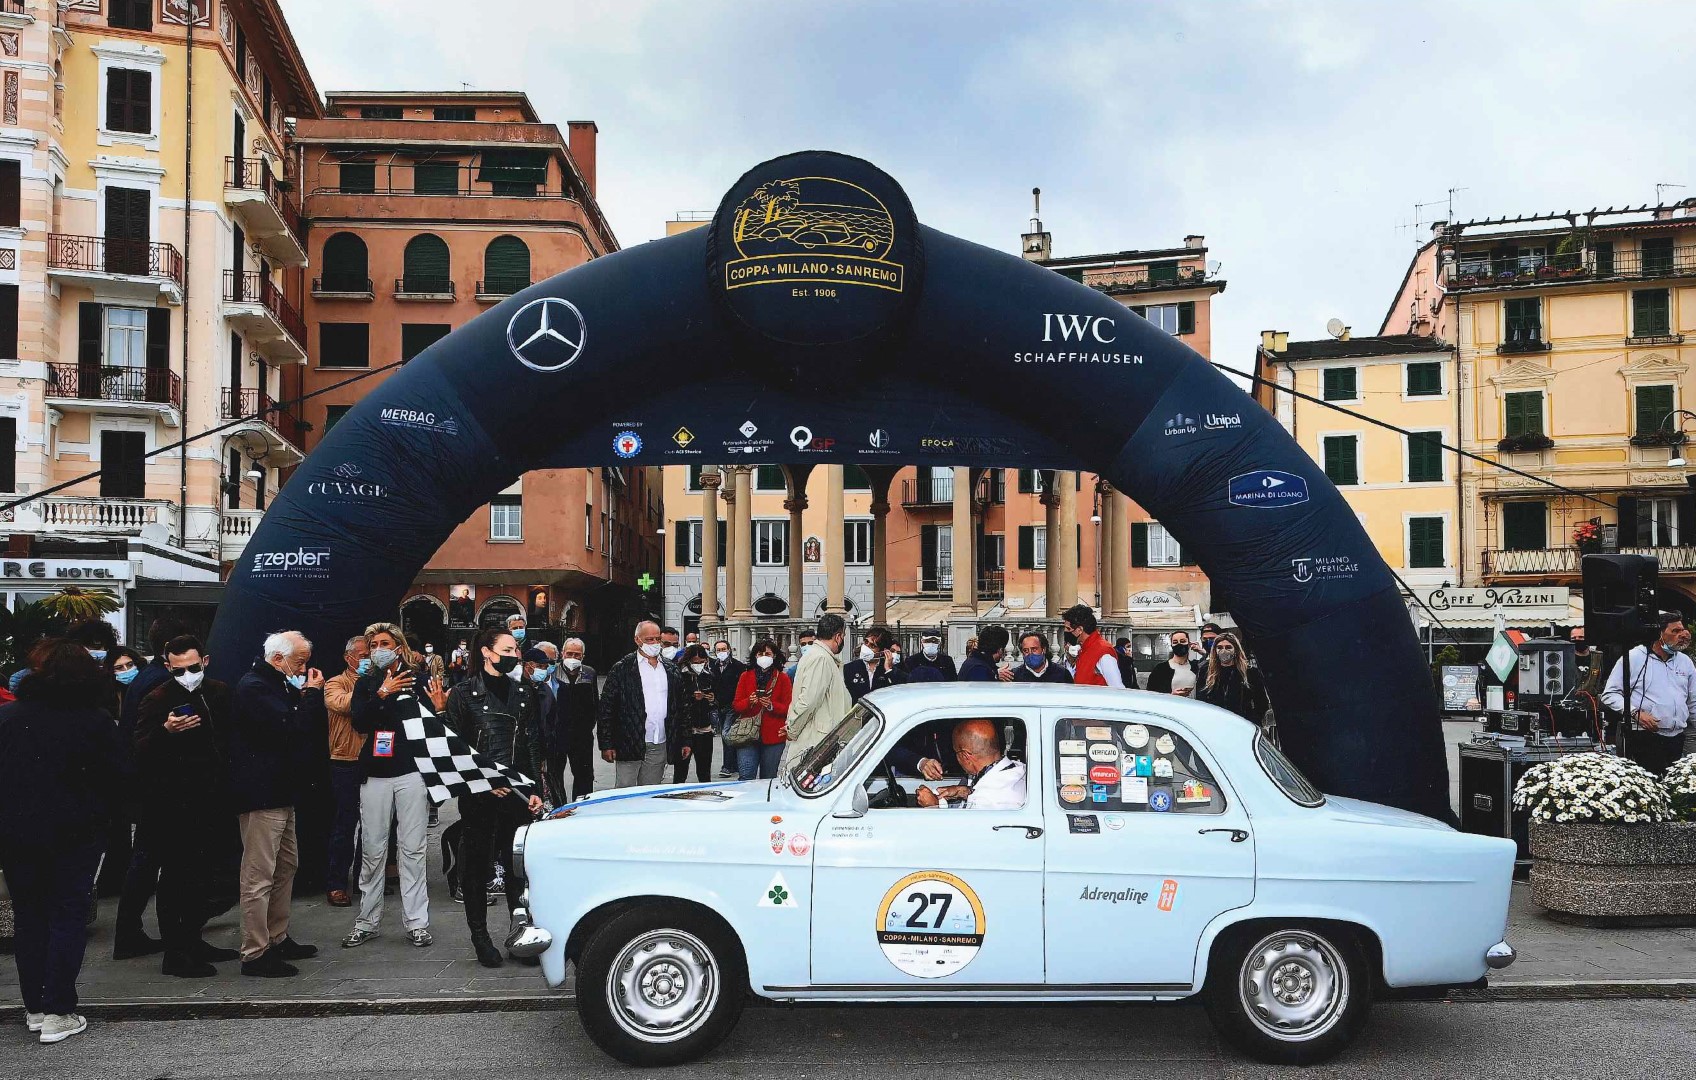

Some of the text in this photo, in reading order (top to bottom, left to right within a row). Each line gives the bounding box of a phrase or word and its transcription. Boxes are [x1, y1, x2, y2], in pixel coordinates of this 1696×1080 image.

[731, 263, 897, 282] COPPA MILANO SANREMO
[792, 289, 836, 297] Est. 1906
[1041, 313, 1116, 344] IWC
[1014, 352, 1144, 365] SCHAFFHAUSEN
[381, 408, 435, 425] MERBAG
[1206, 413, 1241, 428] Unipol
[1164, 426, 1197, 436] Urban Up
[921, 439, 954, 447] EPOCA
[728, 446, 769, 454] SPORT
[308, 482, 388, 498] CUVAGE
[1235, 492, 1266, 500] MARINA
[263, 547, 331, 571] zepter
[1315, 557, 1350, 565] MILANO
[56, 567, 115, 579] HOTEL
[1315, 564, 1359, 573] VERTICALE
[1080, 885, 1149, 904] Adrenaline
[906, 892, 953, 929] 27
[883, 934, 977, 944] COPPA MILANO SANREMO
